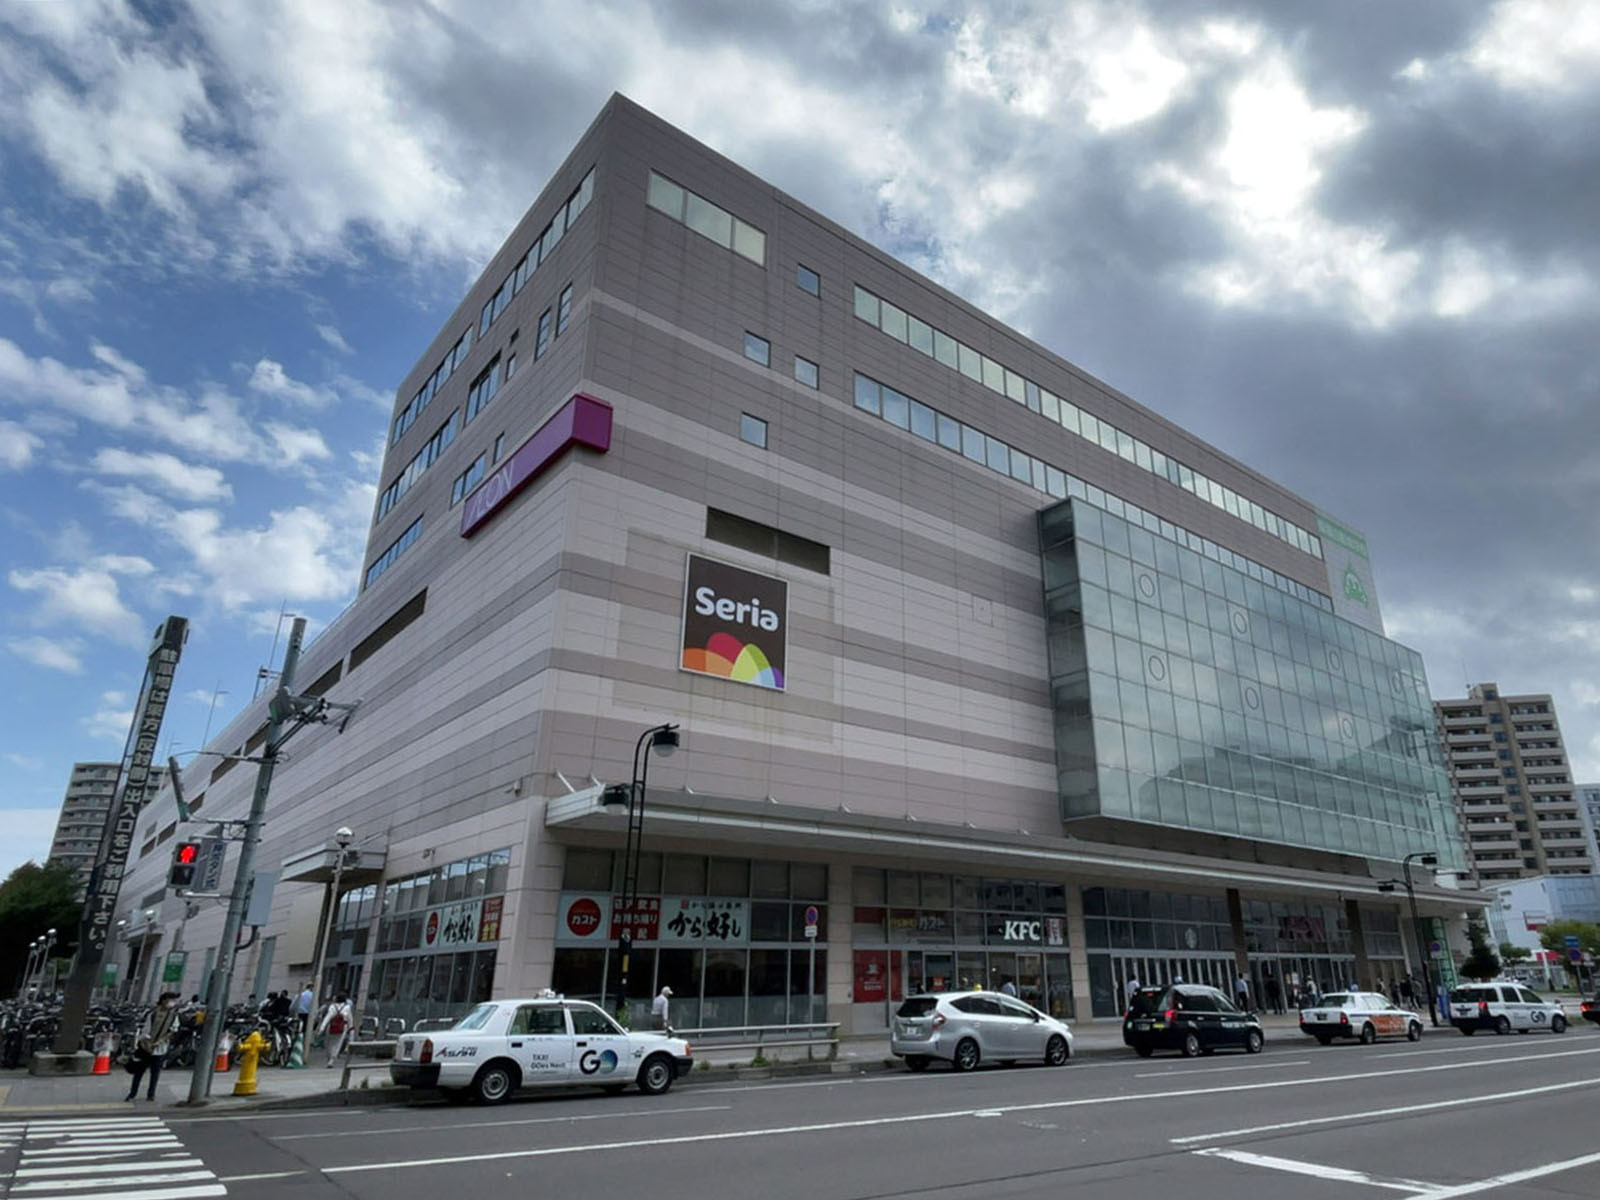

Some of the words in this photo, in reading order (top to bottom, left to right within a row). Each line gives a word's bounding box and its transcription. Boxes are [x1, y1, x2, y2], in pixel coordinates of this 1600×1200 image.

[695, 586, 779, 632] Seria
[667, 911, 742, 940] から好し
[1004, 920, 1041, 940] KFC
